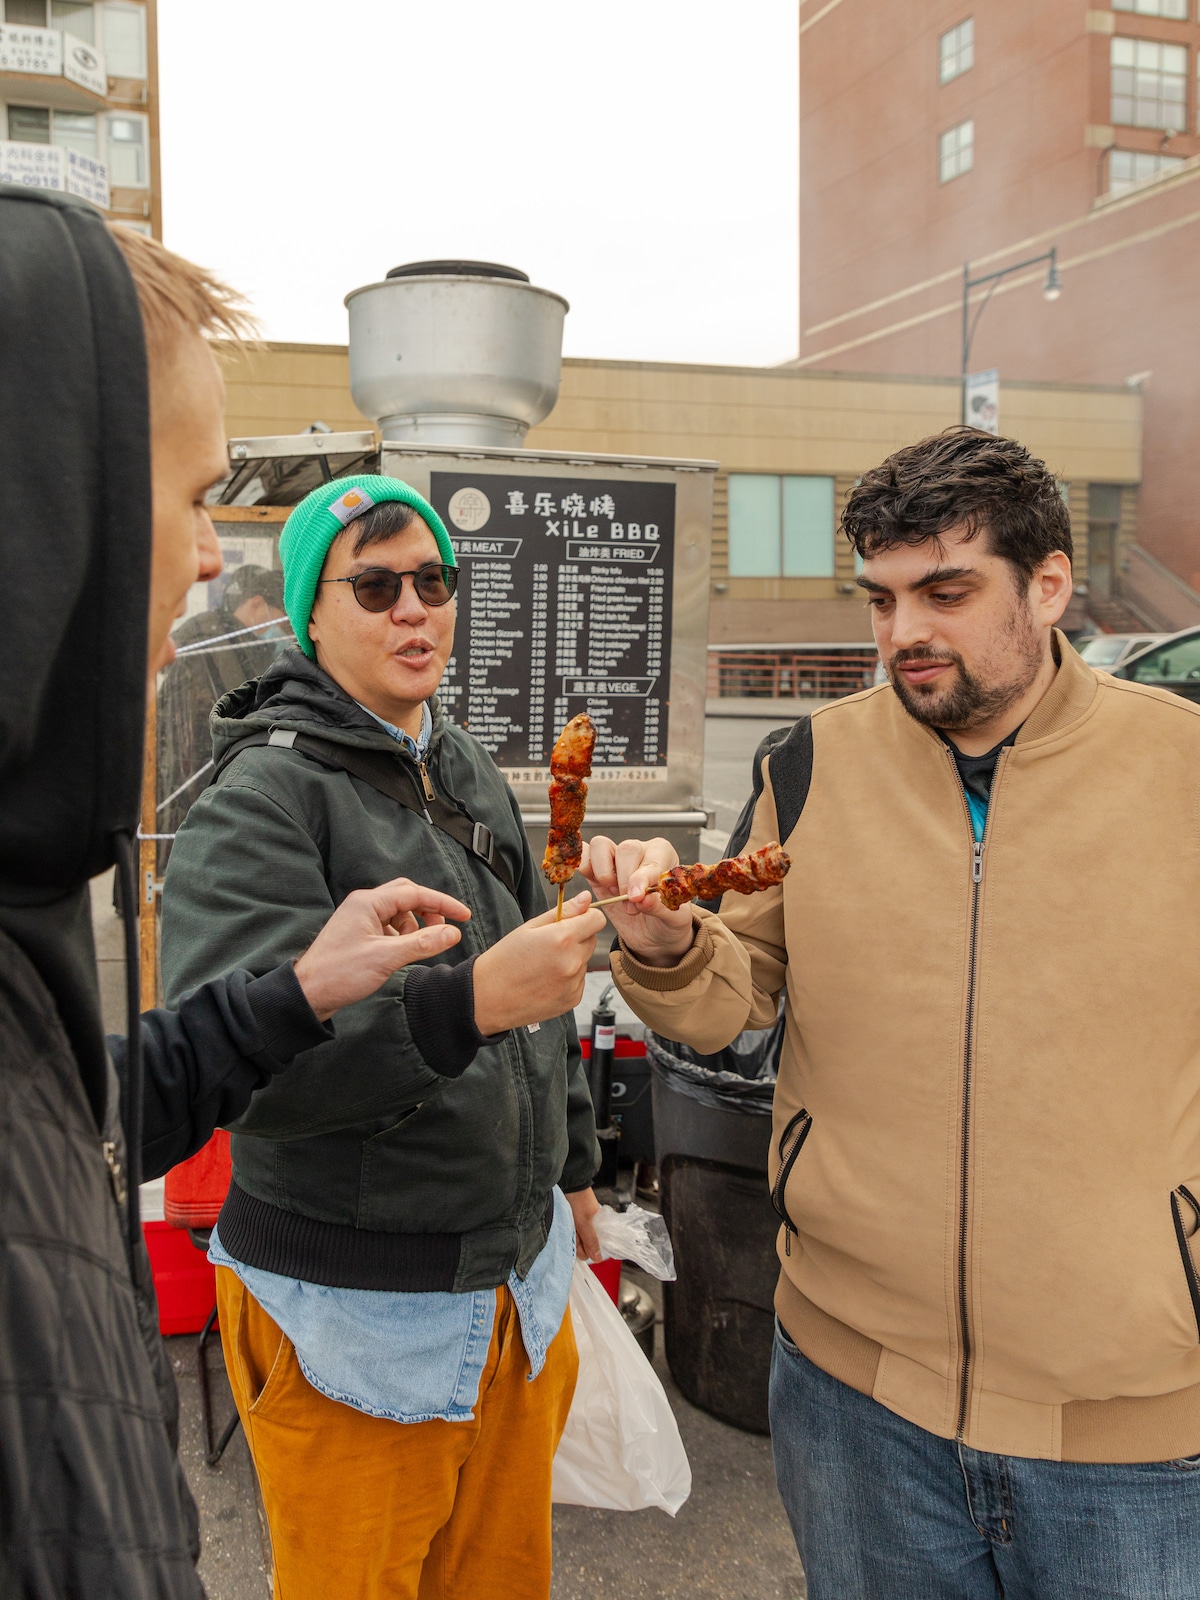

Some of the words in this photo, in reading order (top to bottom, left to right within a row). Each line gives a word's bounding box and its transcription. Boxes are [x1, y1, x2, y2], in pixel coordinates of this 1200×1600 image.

[505, 490, 616, 520] 喜乐烧烤
[545, 520, 599, 538] XiLe
[611, 522, 660, 541] BBQ
[472, 542, 504, 552] MEAT
[578, 546, 610, 558] 油炸类
[613, 548, 645, 559] FRIED
[472, 562, 490, 570] Lamb
[490, 562, 512, 571] Kebab
[533, 564, 548, 572] 2.00
[472, 572, 490, 580] Lamb
[490, 572, 512, 582] Kidney
[472, 582, 490, 590] Lamb
[490, 582, 514, 590] Tendon
[590, 584, 606, 592] Fried
[471, 591, 486, 599] Beef
[486, 592, 508, 600] Kebab
[590, 594, 606, 602] Fried
[471, 600, 486, 608] Beef
[590, 603, 606, 612] Fried
[471, 610, 486, 618] Beef
[487, 610, 510, 618] Tendon
[590, 612, 606, 620] Fried
[470, 620, 496, 628] Chicken
[470, 629, 496, 637] Chicken
[496, 630, 524, 638] Gizzards
[470, 638, 496, 646] Chicken
[496, 639, 514, 647] Heart
[589, 640, 605, 648] Fried
[470, 648, 496, 656] Chicken
[496, 648, 512, 658] Wing
[588, 650, 604, 658] Fried
[470, 658, 484, 666] Pork
[588, 658, 604, 666] Fried
[470, 668, 488, 676] Squid
[469, 677, 486, 685] Quail
[469, 686, 492, 694] Taiwan
[492, 686, 520, 696] Sausage
[573, 682, 607, 692] 蔬菜类
[608, 682, 640, 692] VEGE.
[468, 696, 482, 704] Fish
[483, 696, 498, 704] Tofu
[468, 706, 482, 714] Fish
[586, 707, 614, 716] Eggplant
[468, 715, 484, 723] Ham
[484, 715, 512, 724] Sausage
